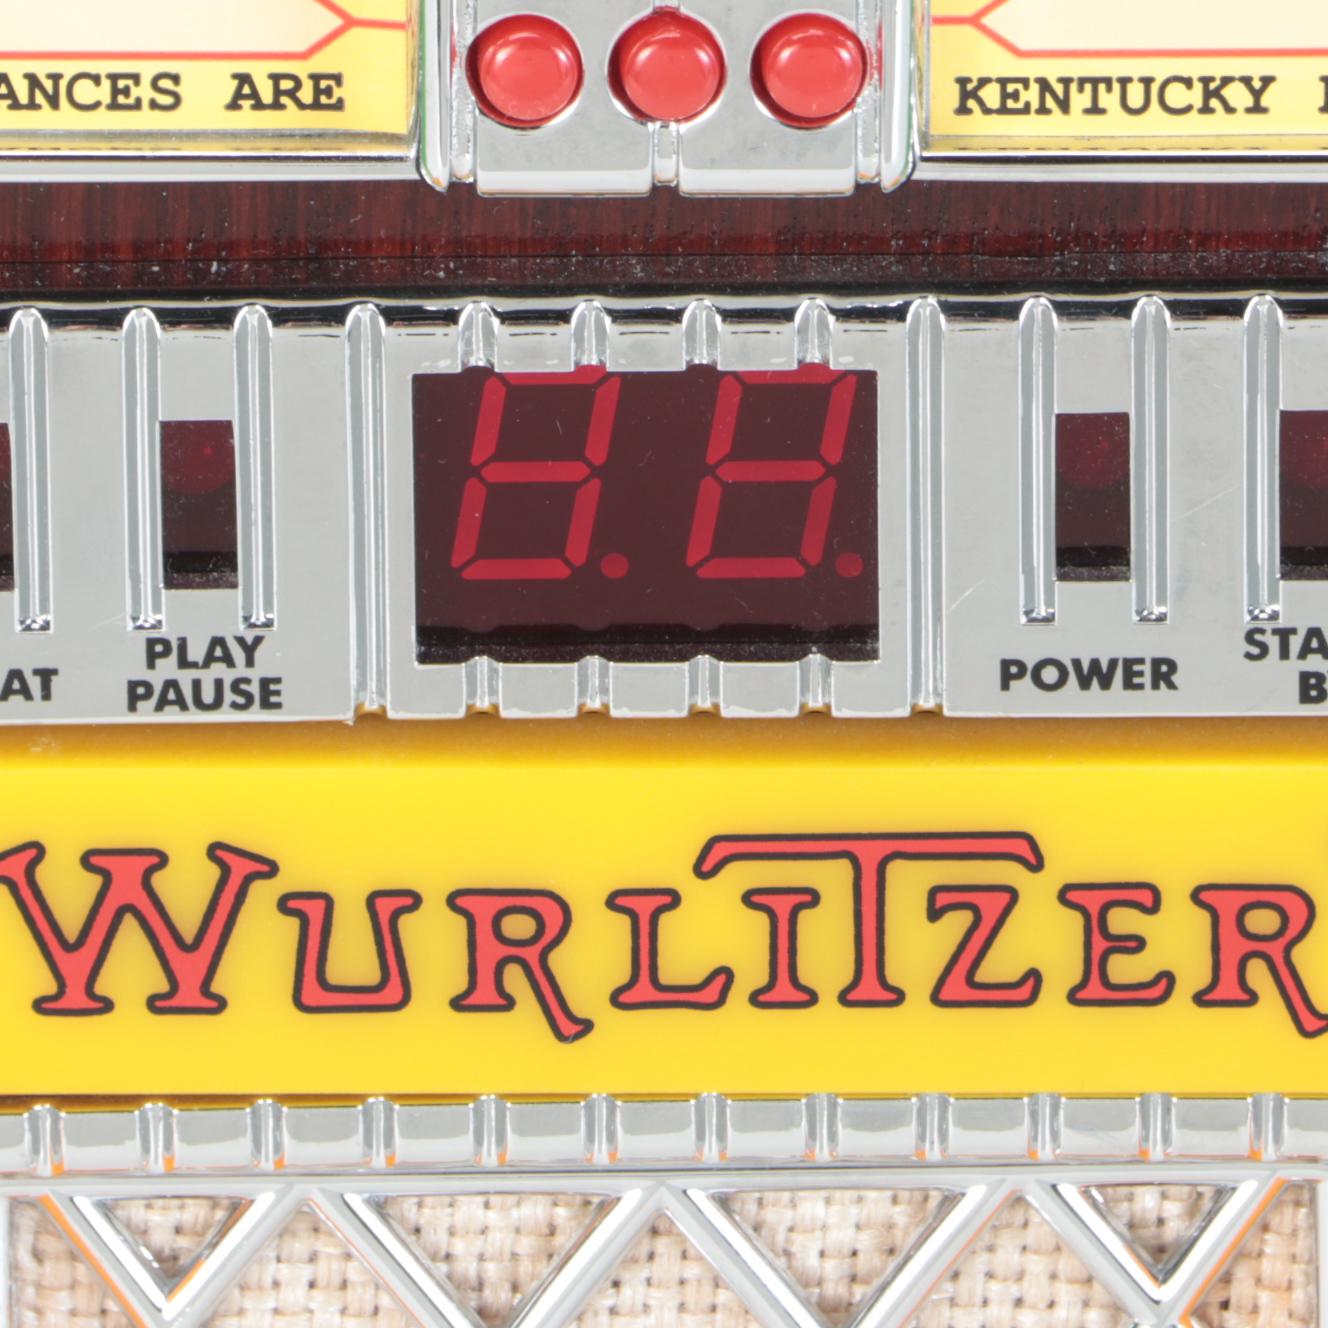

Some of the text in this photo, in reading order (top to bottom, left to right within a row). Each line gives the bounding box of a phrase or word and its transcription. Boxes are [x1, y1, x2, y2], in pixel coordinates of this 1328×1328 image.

[226, 73, 343, 111] ARE
[955, 76, 1275, 115] KENTUCKY
[145, 634, 265, 671] PLAY
[999, 657, 1179, 692] POWER
[127, 676, 283, 713] PAUSE
